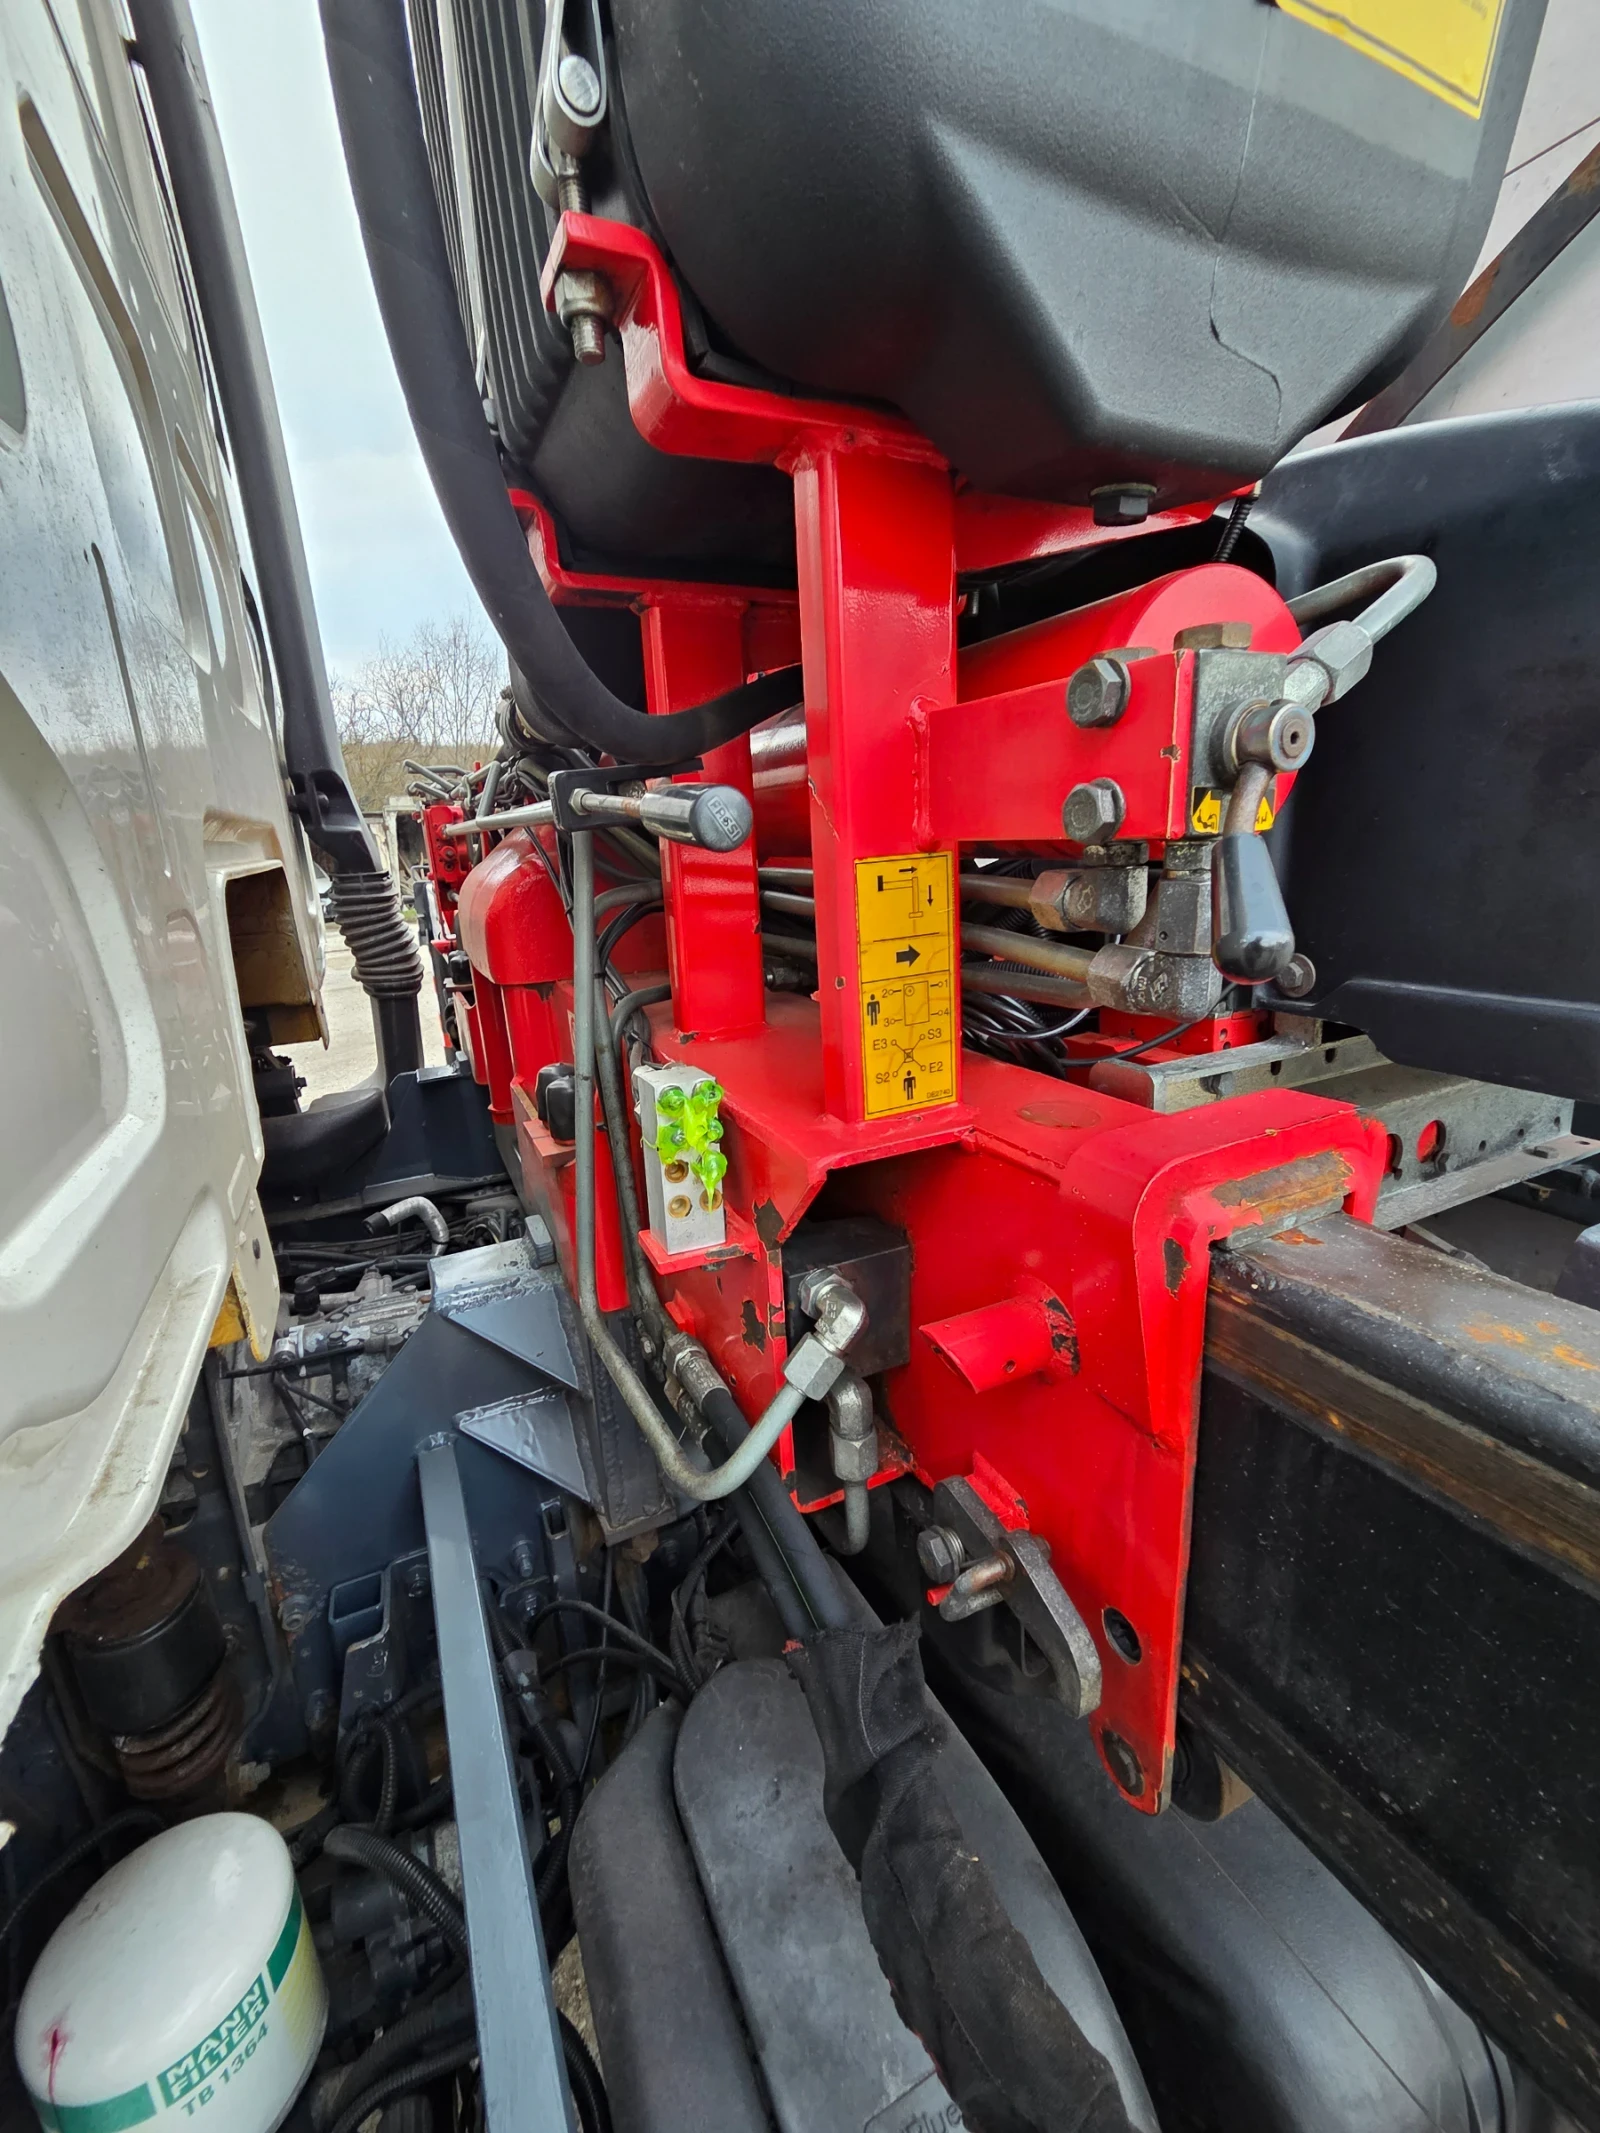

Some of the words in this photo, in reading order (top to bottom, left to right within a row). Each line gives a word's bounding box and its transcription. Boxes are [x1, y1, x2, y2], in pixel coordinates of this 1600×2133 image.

[709, 799, 741, 839] FASSI
[881, 989, 888, 998] 2
[883, 1018, 890, 1027] 3
[927, 1028, 942, 1040] S3
[873, 1038, 888, 1051] E3
[929, 1061, 943, 1073] E2
[875, 1071, 890, 1084] S2
[165, 1981, 262, 2086] MANN
[170, 1995, 266, 2100] FILTER
[180, 2084, 215, 2117] TB
[218, 2021, 270, 2085] 1364
